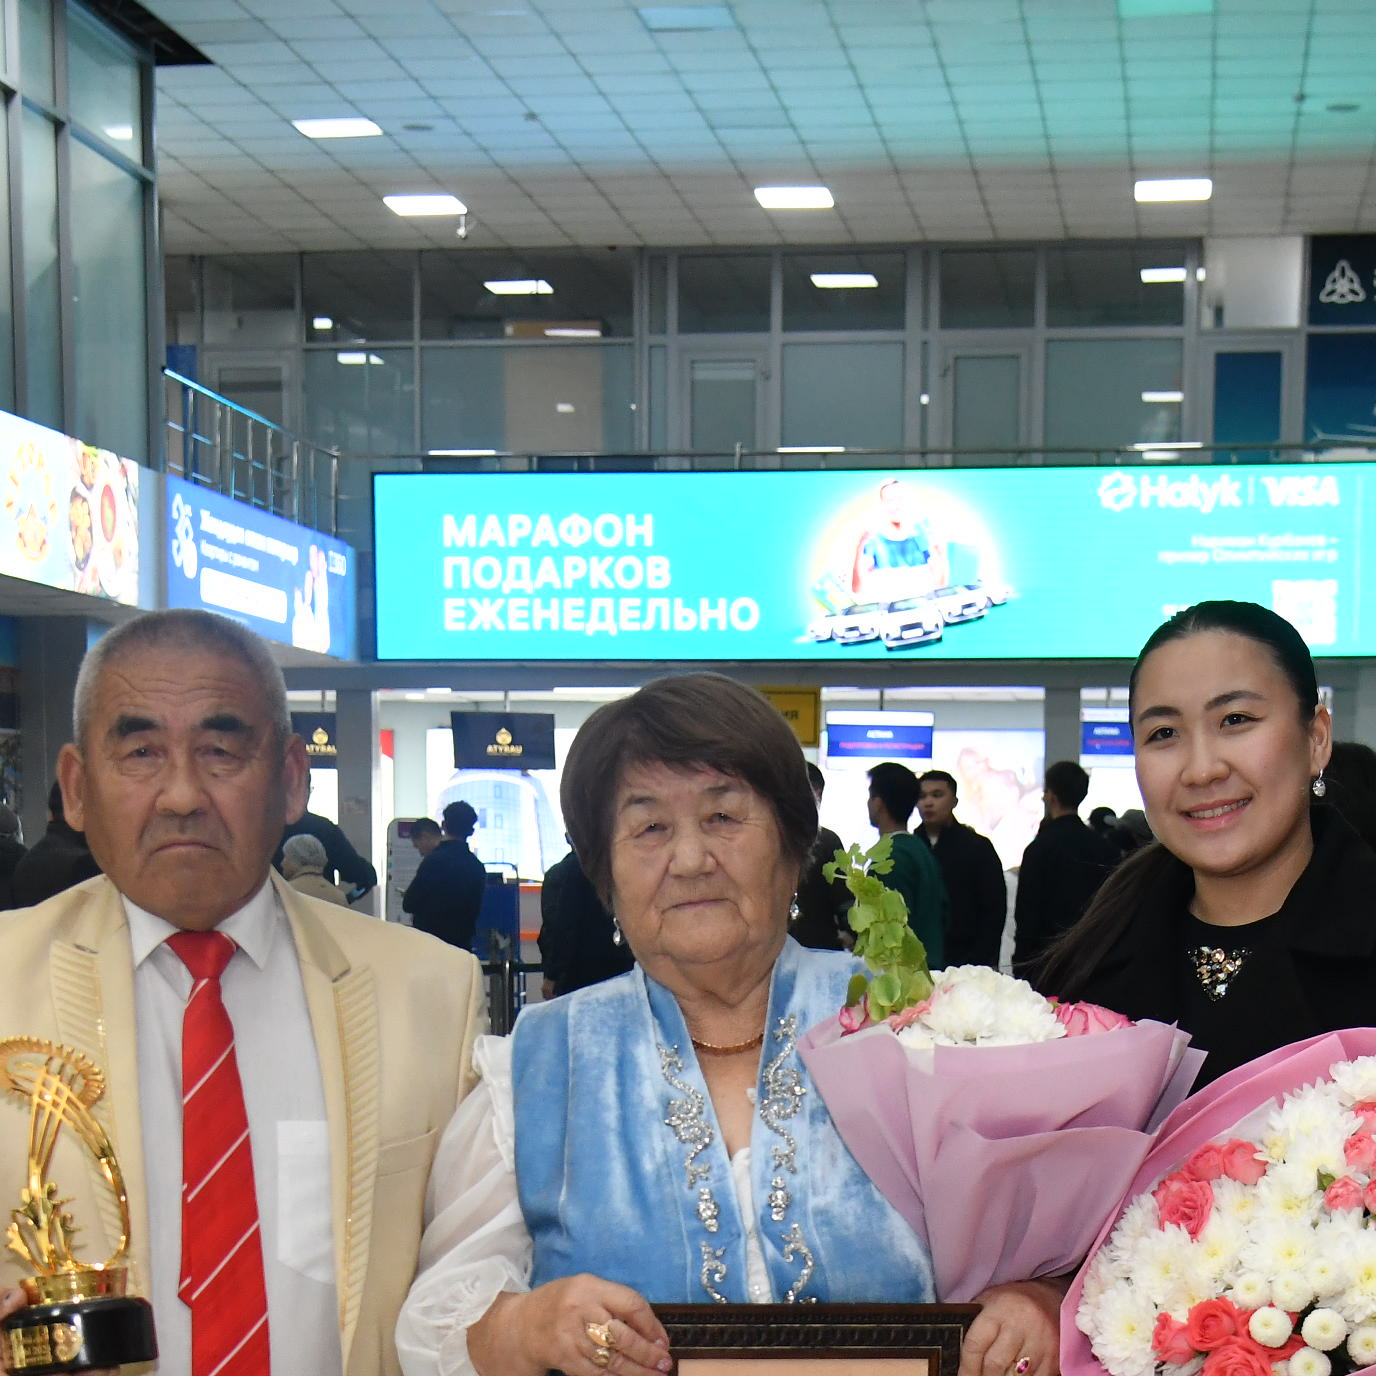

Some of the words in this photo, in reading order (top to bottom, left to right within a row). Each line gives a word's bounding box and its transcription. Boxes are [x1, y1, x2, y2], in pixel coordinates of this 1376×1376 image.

[1140, 474, 1242, 514] Halyk
[1261, 475, 1340, 506] VISA
[443, 513, 654, 548] МАРАФОН
[443, 555, 672, 594] ПОДАРКОВ
[444, 596, 760, 636] ЕЖЕНЕДЕЛЬНО
